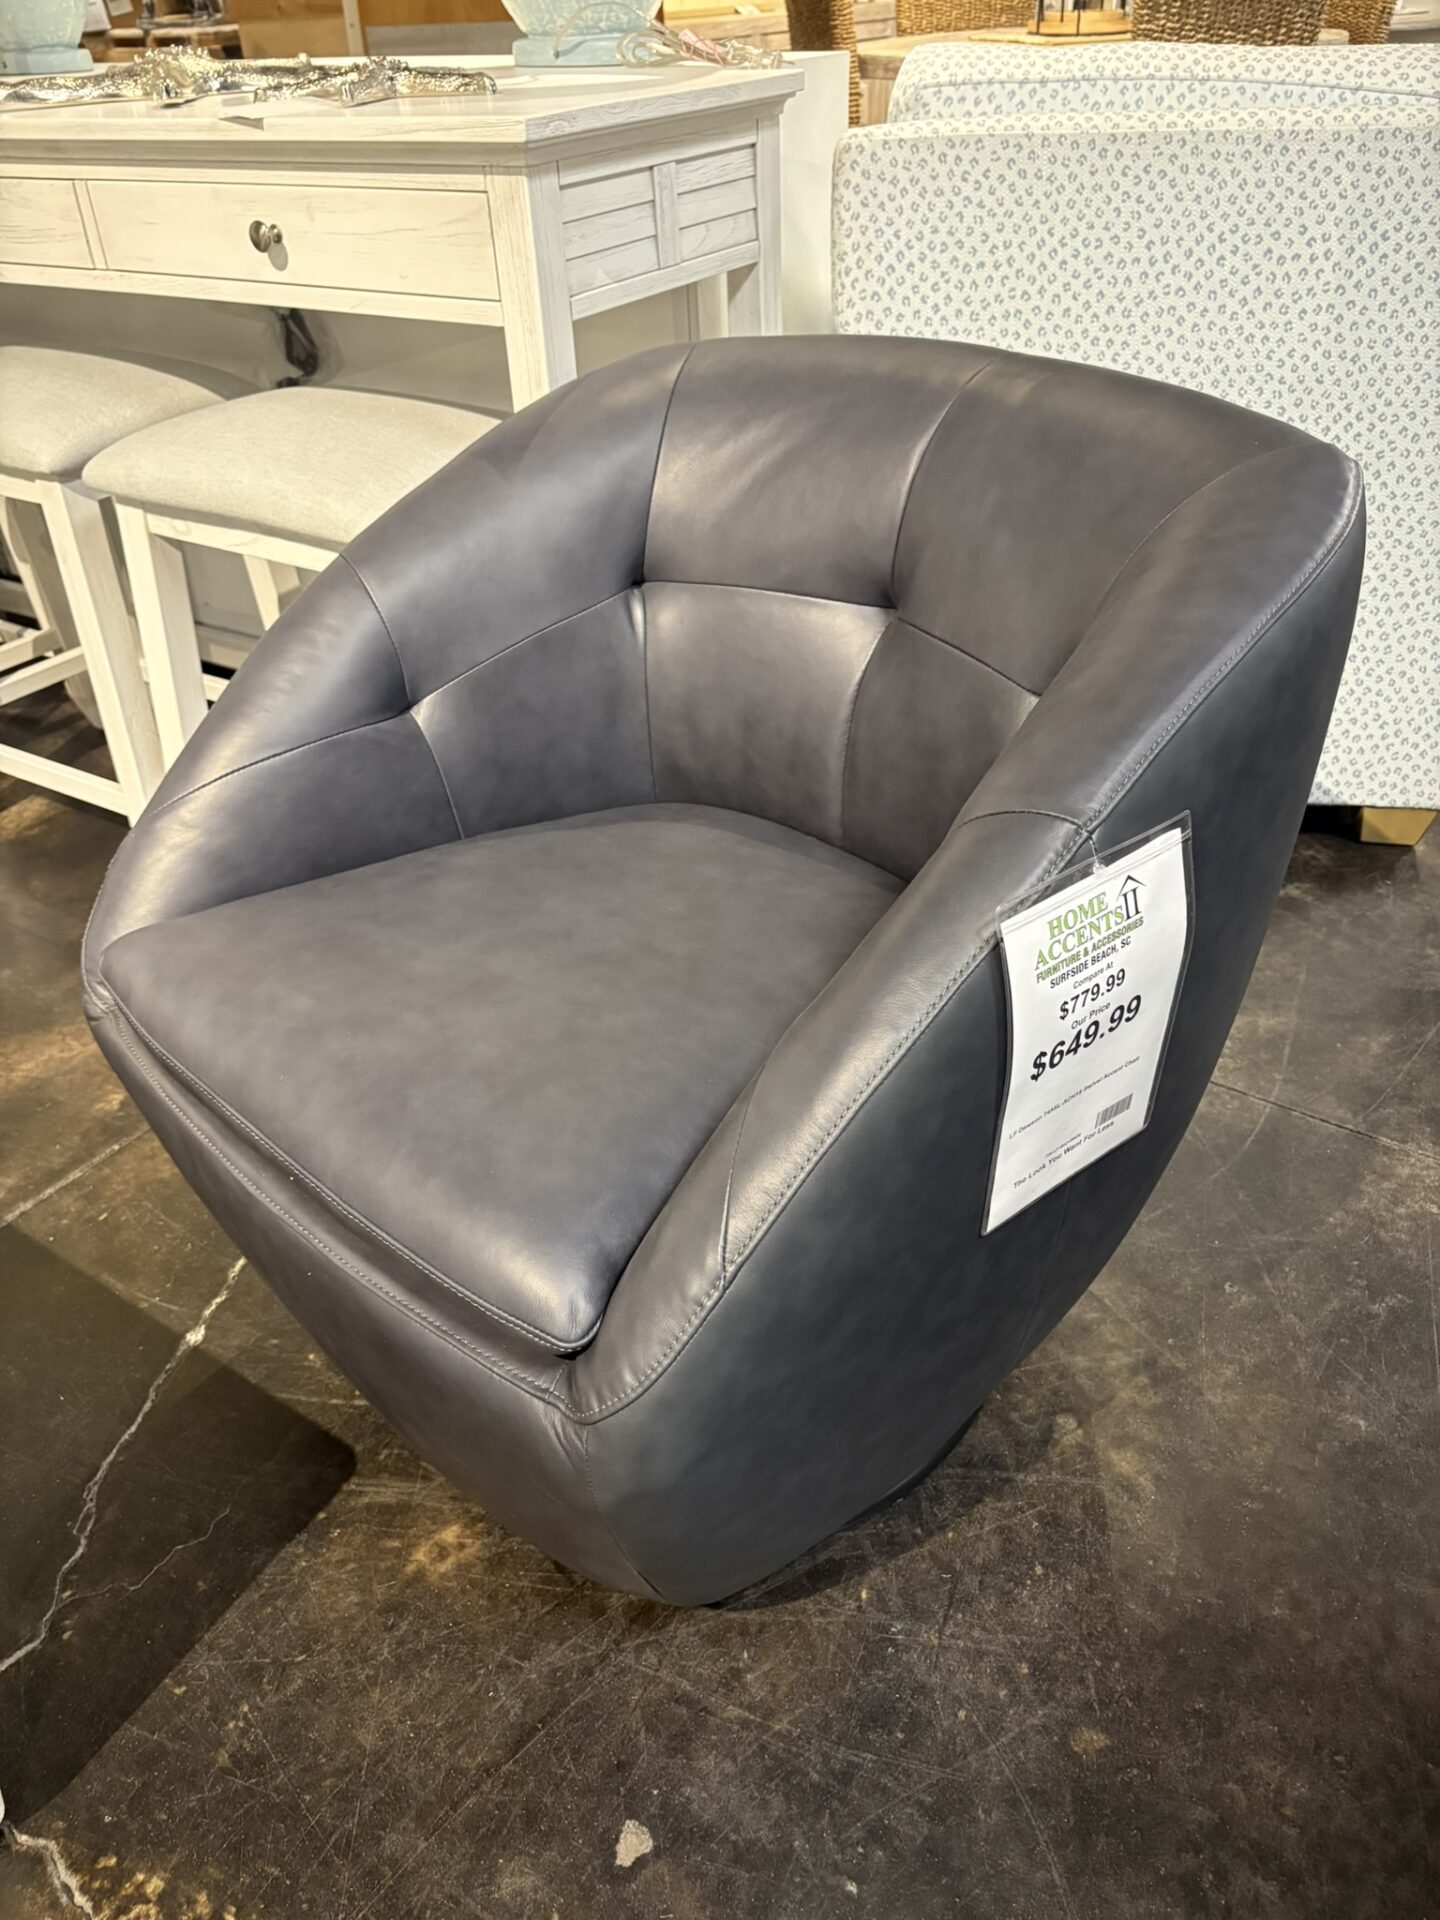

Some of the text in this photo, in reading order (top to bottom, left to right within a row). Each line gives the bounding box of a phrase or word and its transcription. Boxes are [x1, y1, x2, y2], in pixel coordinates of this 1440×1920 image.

[1034, 905, 1125, 971] ACCENTS
[1046, 891, 1109, 940] HOME
[1036, 916, 1144, 984] FURNITURE & ACCESSORIES
[1050, 959, 1089, 989] SURFSIDE
[1120, 936, 1131, 949] SC
[1073, 961, 1114, 990] Compare At
[1059, 968, 1126, 1021] $779.99
[1071, 1002, 1111, 1030] Our Price
[1030, 994, 1142, 1082] $649.99
[1014, 1177, 1027, 1189] The
[1028, 1163, 1046, 1179] Look
[1048, 1153, 1062, 1165] You
[1063, 1139, 1082, 1155] Want
[1083, 1131, 1097, 1143] For
[1097, 1120, 1114, 1134] Less
